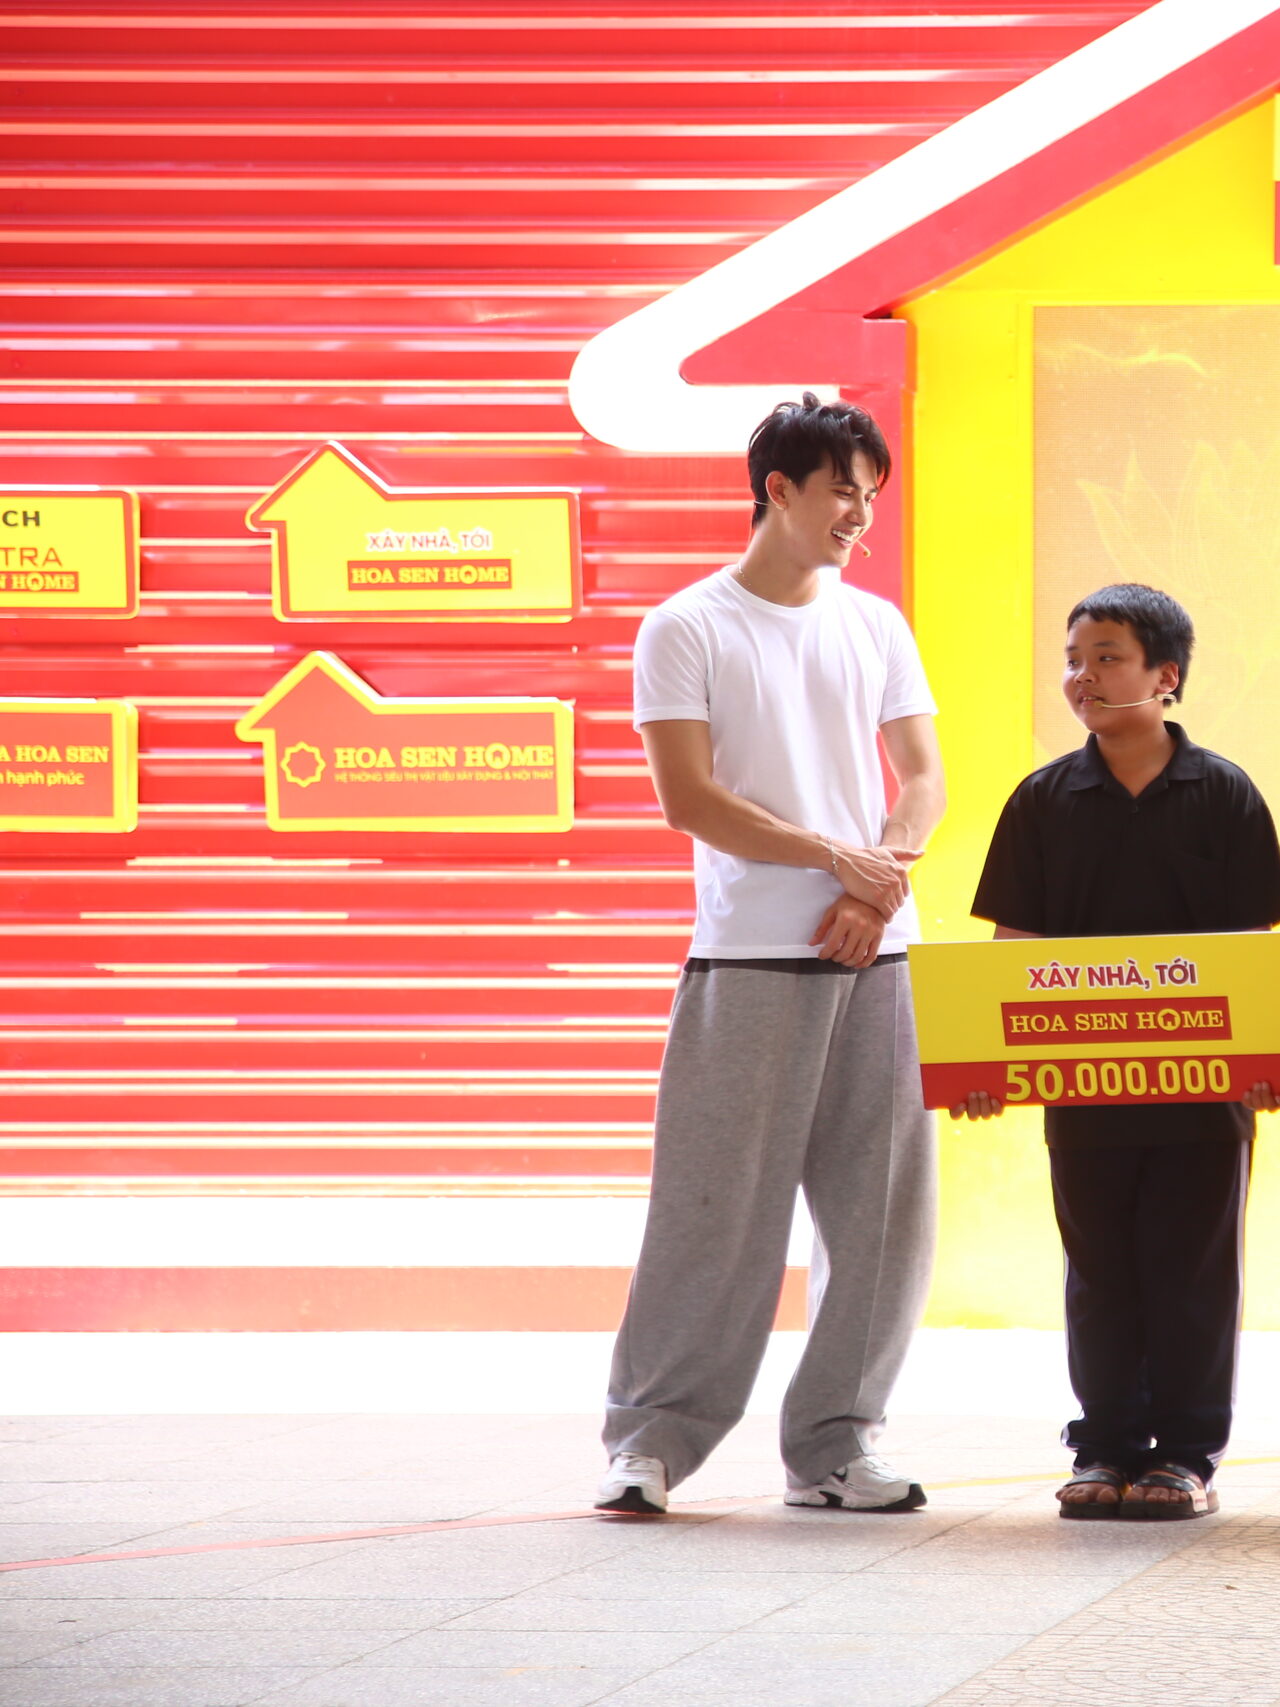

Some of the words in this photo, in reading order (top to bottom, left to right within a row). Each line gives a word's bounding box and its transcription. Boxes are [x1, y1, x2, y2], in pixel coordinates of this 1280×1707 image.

[368, 529, 406, 550] XÂY
[410, 527, 458, 552] NHÀ,
[460, 527, 491, 549] TỚI
[12, 571, 76, 592] HOME
[351, 567, 396, 584] HOA
[398, 566, 440, 583] SEN
[444, 564, 509, 585] HOME
[15, 744, 63, 763] HOA
[65, 745, 110, 763] SEN
[334, 746, 397, 769] HOA
[401, 745, 458, 768] SEN
[463, 742, 555, 770] HOME
[6, 769, 45, 788] hạnh
[47, 769, 86, 787] phúc
[1027, 960, 1081, 990] XÂY
[1087, 957, 1151, 990] NHÀ,
[1155, 956, 1197, 986] TỚI
[1009, 1013, 1069, 1034] HOA
[1074, 1011, 1129, 1033] SEN
[1136, 1007, 1225, 1032] HOME
[1005, 1058, 1232, 1102] 50.000.000
